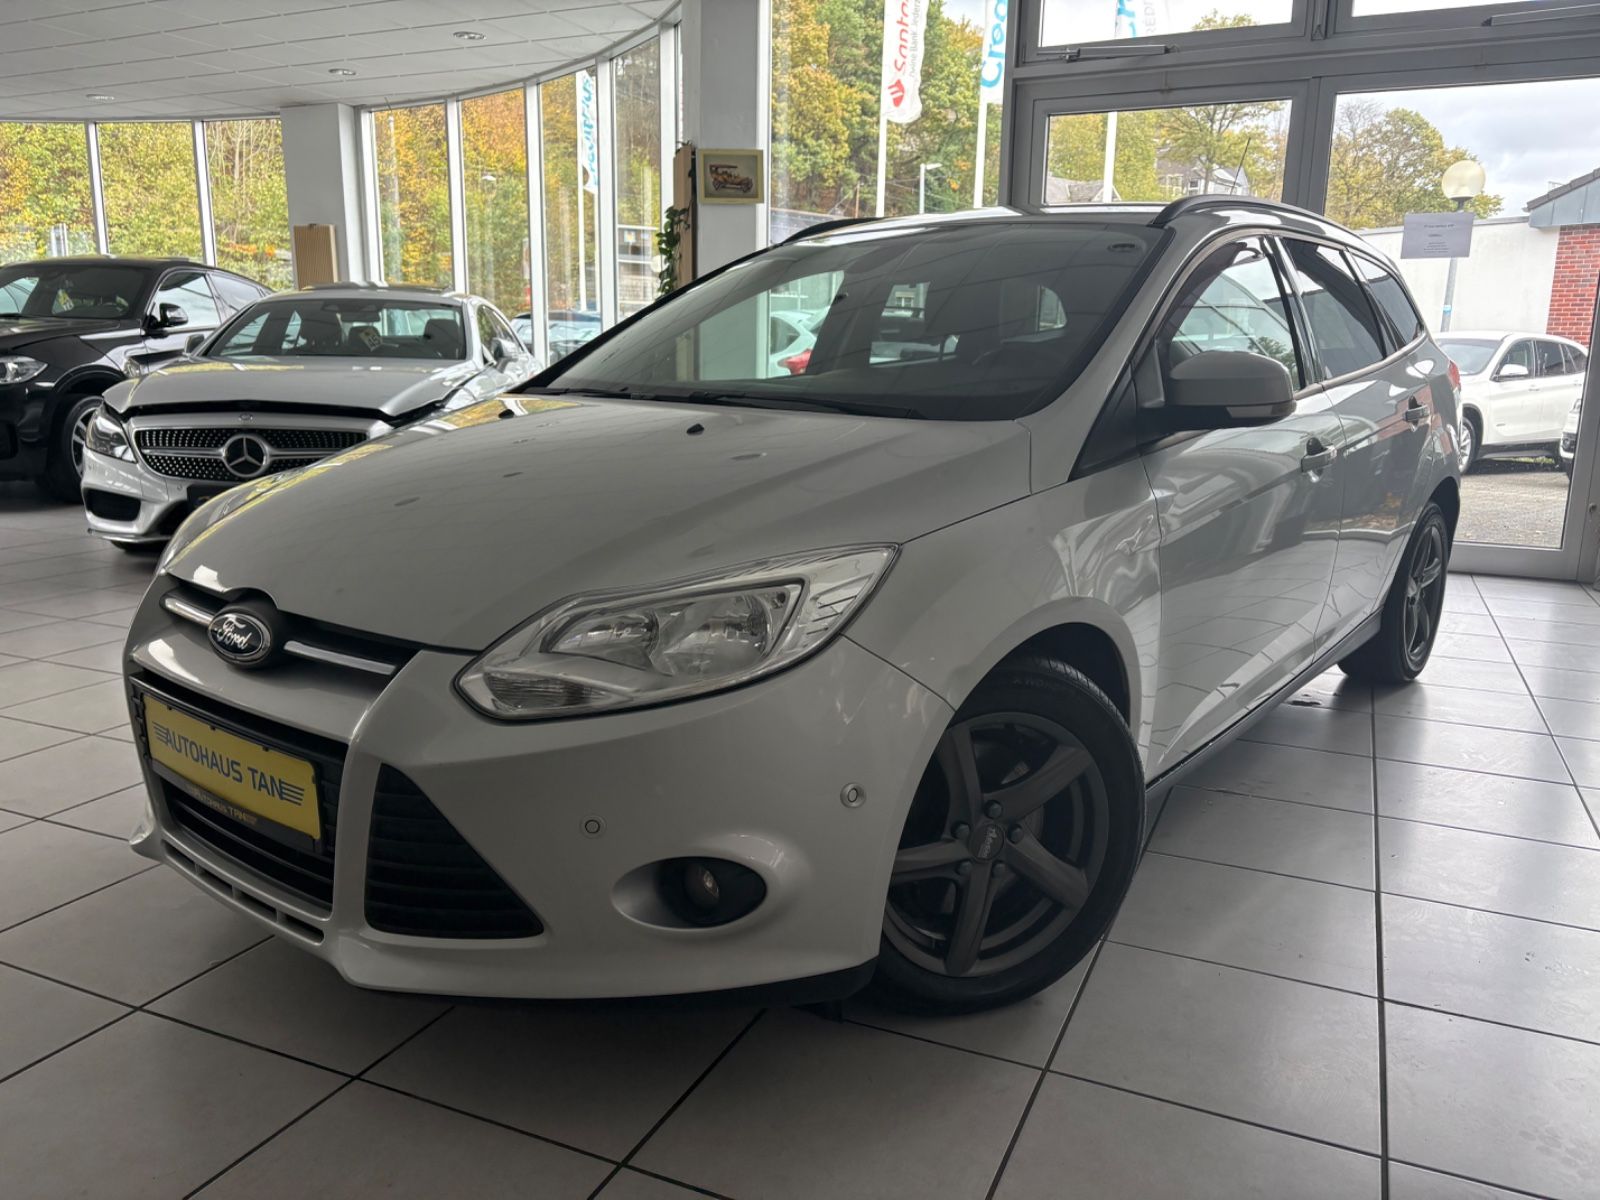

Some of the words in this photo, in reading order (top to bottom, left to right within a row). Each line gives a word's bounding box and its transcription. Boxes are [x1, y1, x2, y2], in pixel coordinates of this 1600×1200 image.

[895, 0, 909, 72] Santa
[214, 614, 253, 650] Ford
[165, 727, 243, 784] AUTOHAUS
[247, 766, 285, 800] TAN
